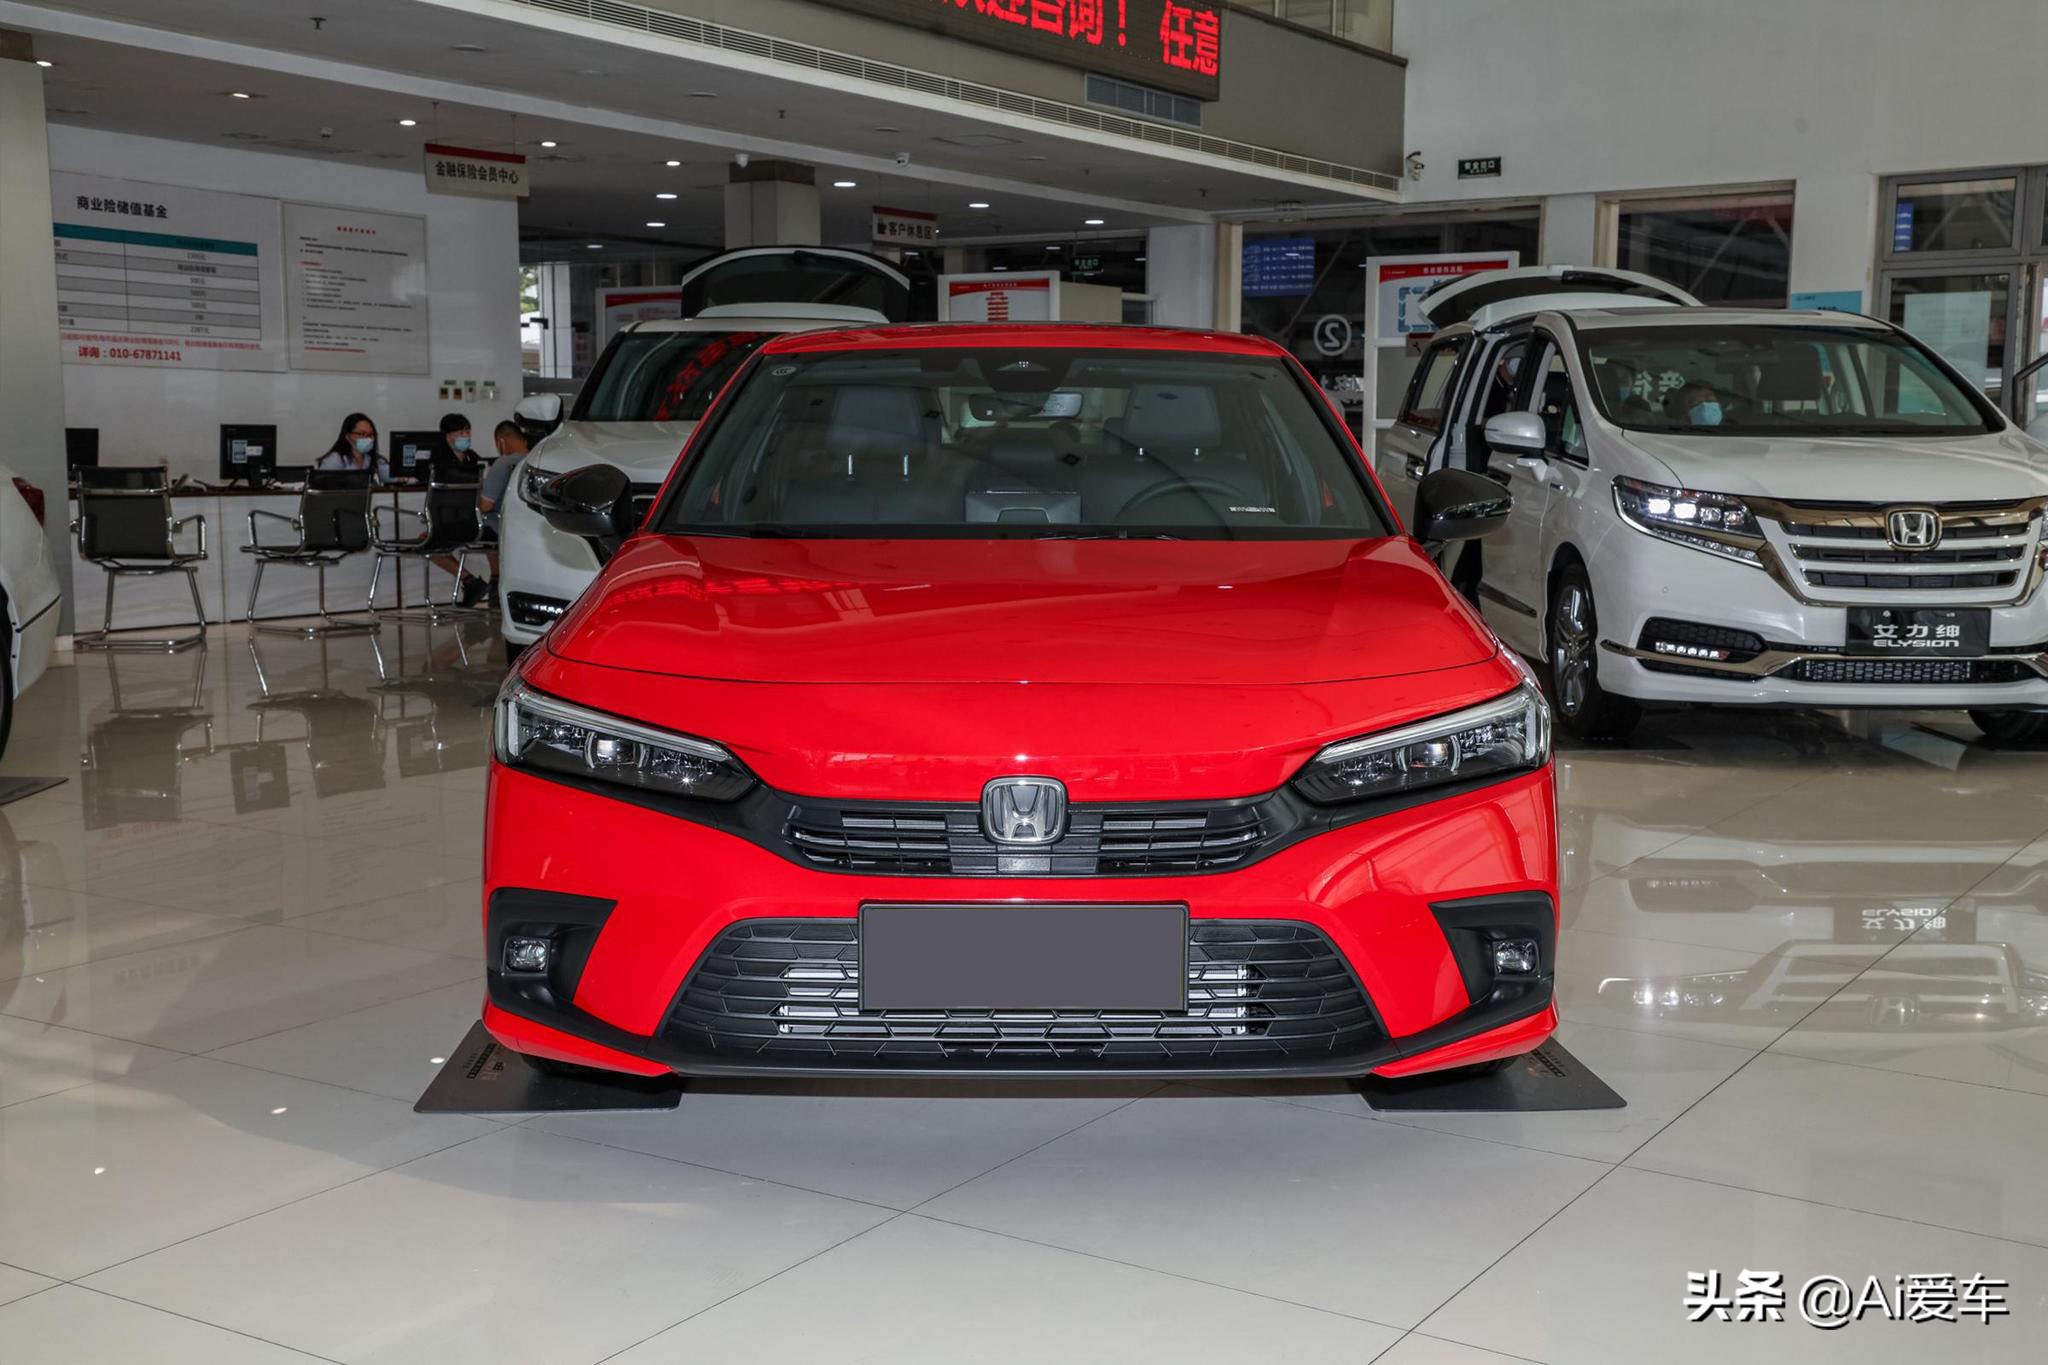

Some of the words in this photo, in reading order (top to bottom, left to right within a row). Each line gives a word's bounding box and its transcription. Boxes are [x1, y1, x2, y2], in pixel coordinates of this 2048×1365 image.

[1159, 1, 1219, 76] 任意
[435, 161, 519, 184] 金融保险会员中心
[76, 196, 168, 219] 商业险储值基金
[1873, 624, 1960, 638] 艾力绅
[1873, 639, 1960, 648] ELYSION
